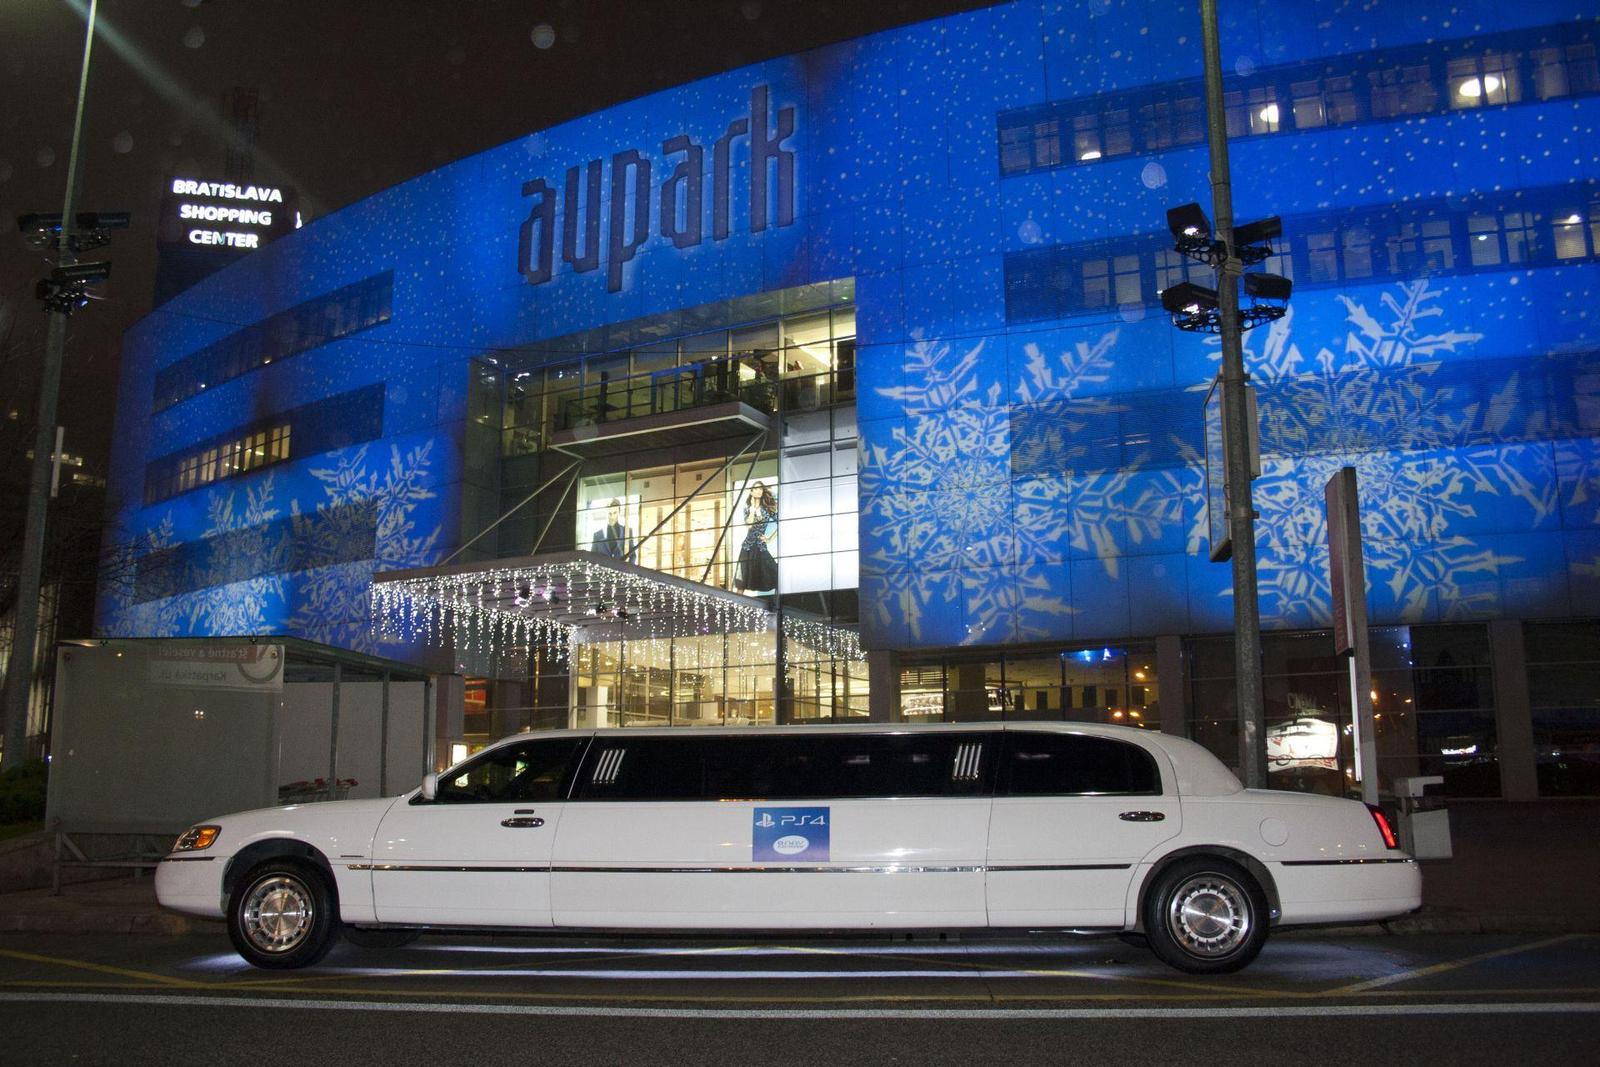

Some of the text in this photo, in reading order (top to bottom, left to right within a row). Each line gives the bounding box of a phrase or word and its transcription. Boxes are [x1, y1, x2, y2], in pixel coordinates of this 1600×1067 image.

[172, 179, 283, 203] BRATISLAVA
[518, 85, 795, 293] aupark
[179, 204, 272, 226] SHOPPING
[188, 229, 259, 249] CENTER
[780, 815, 826, 826] PS4
